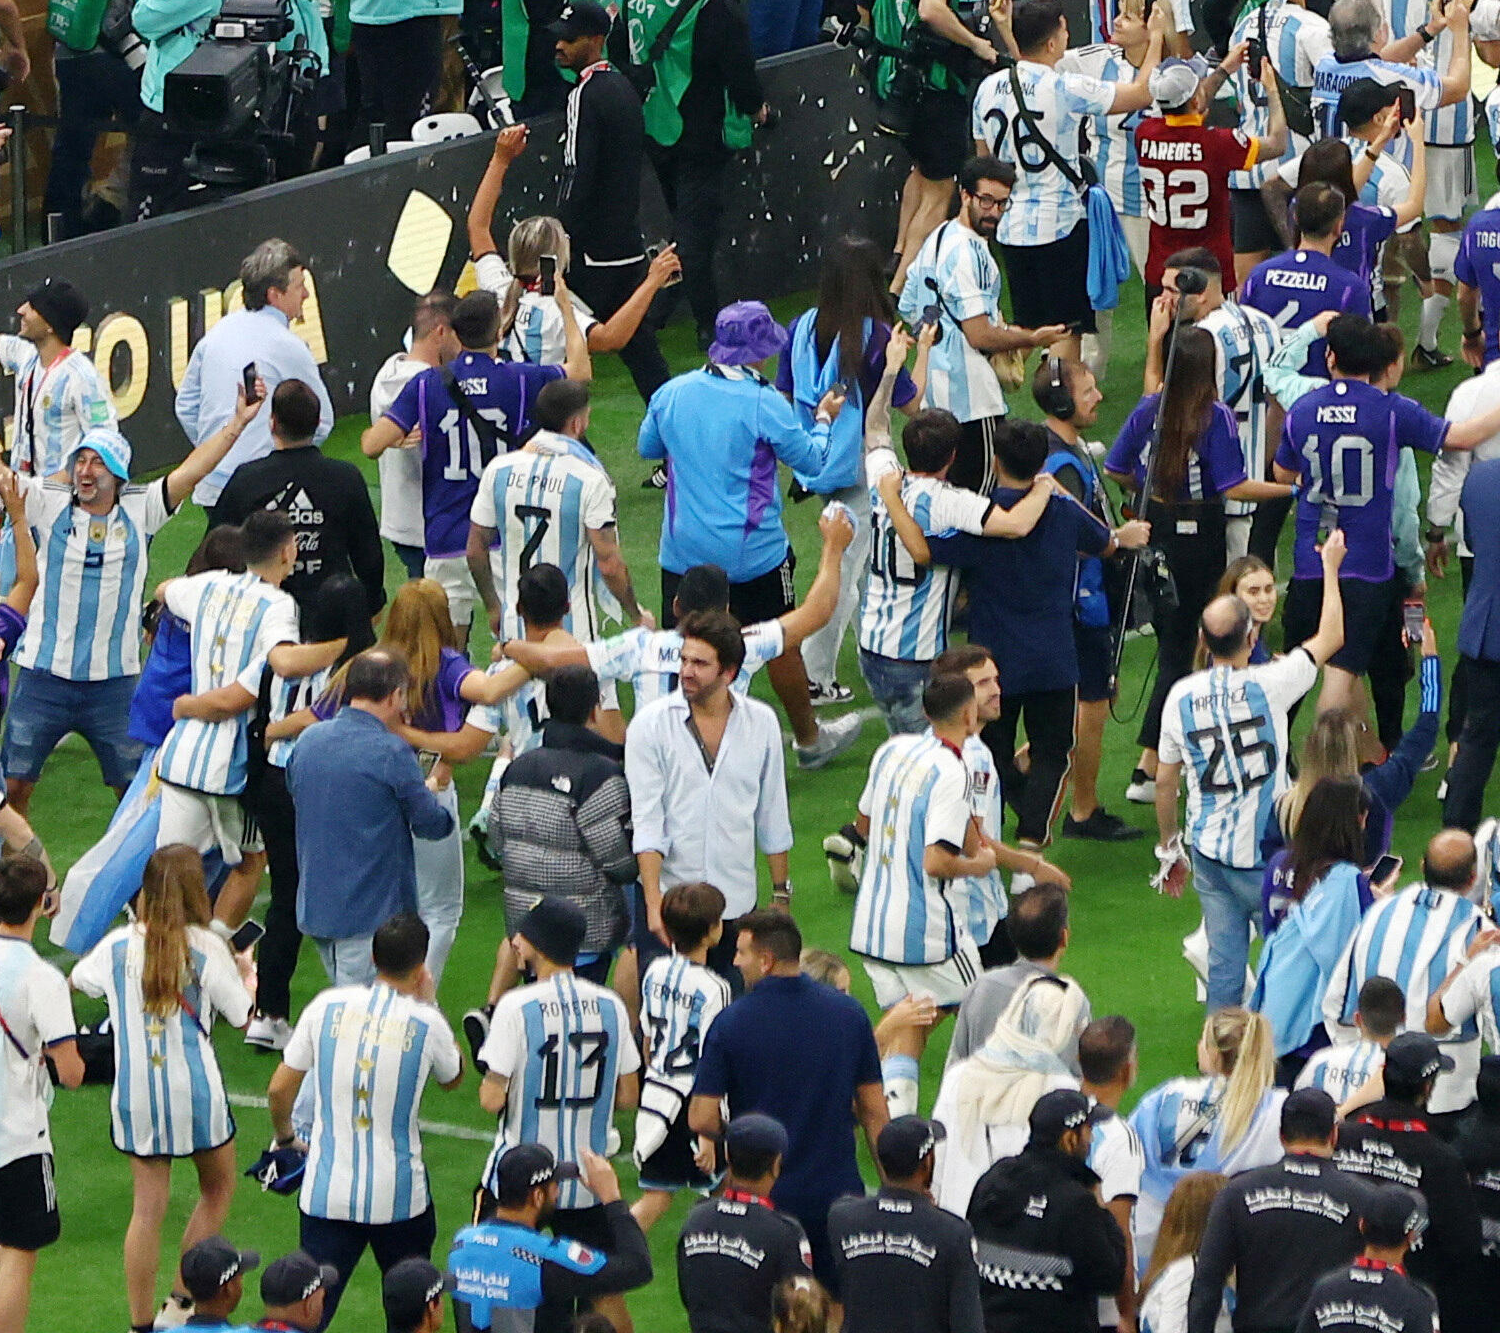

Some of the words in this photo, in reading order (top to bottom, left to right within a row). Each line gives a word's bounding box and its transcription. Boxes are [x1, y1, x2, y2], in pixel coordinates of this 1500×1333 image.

[983, 108, 1066, 173] 26
[1140, 130, 1202, 160] PAREDES
[1264, 271, 1328, 292] PEZZELLA
[1317, 405, 1356, 424] MESSI
[439, 405, 507, 481] 10
[506, 472, 527, 488] DE
[530, 474, 565, 494] PAUL
[1302, 433, 1374, 507] 10
[515, 505, 551, 571] 7
[1186, 716, 1277, 791] 25
[540, 997, 601, 1017] ROMERO
[650, 1013, 702, 1077] 24
[536, 1030, 609, 1108] 13
[1284, 1163, 1320, 1175] POLICE
[717, 1201, 747, 1215] POLICE
[877, 1200, 913, 1213] POLICE
